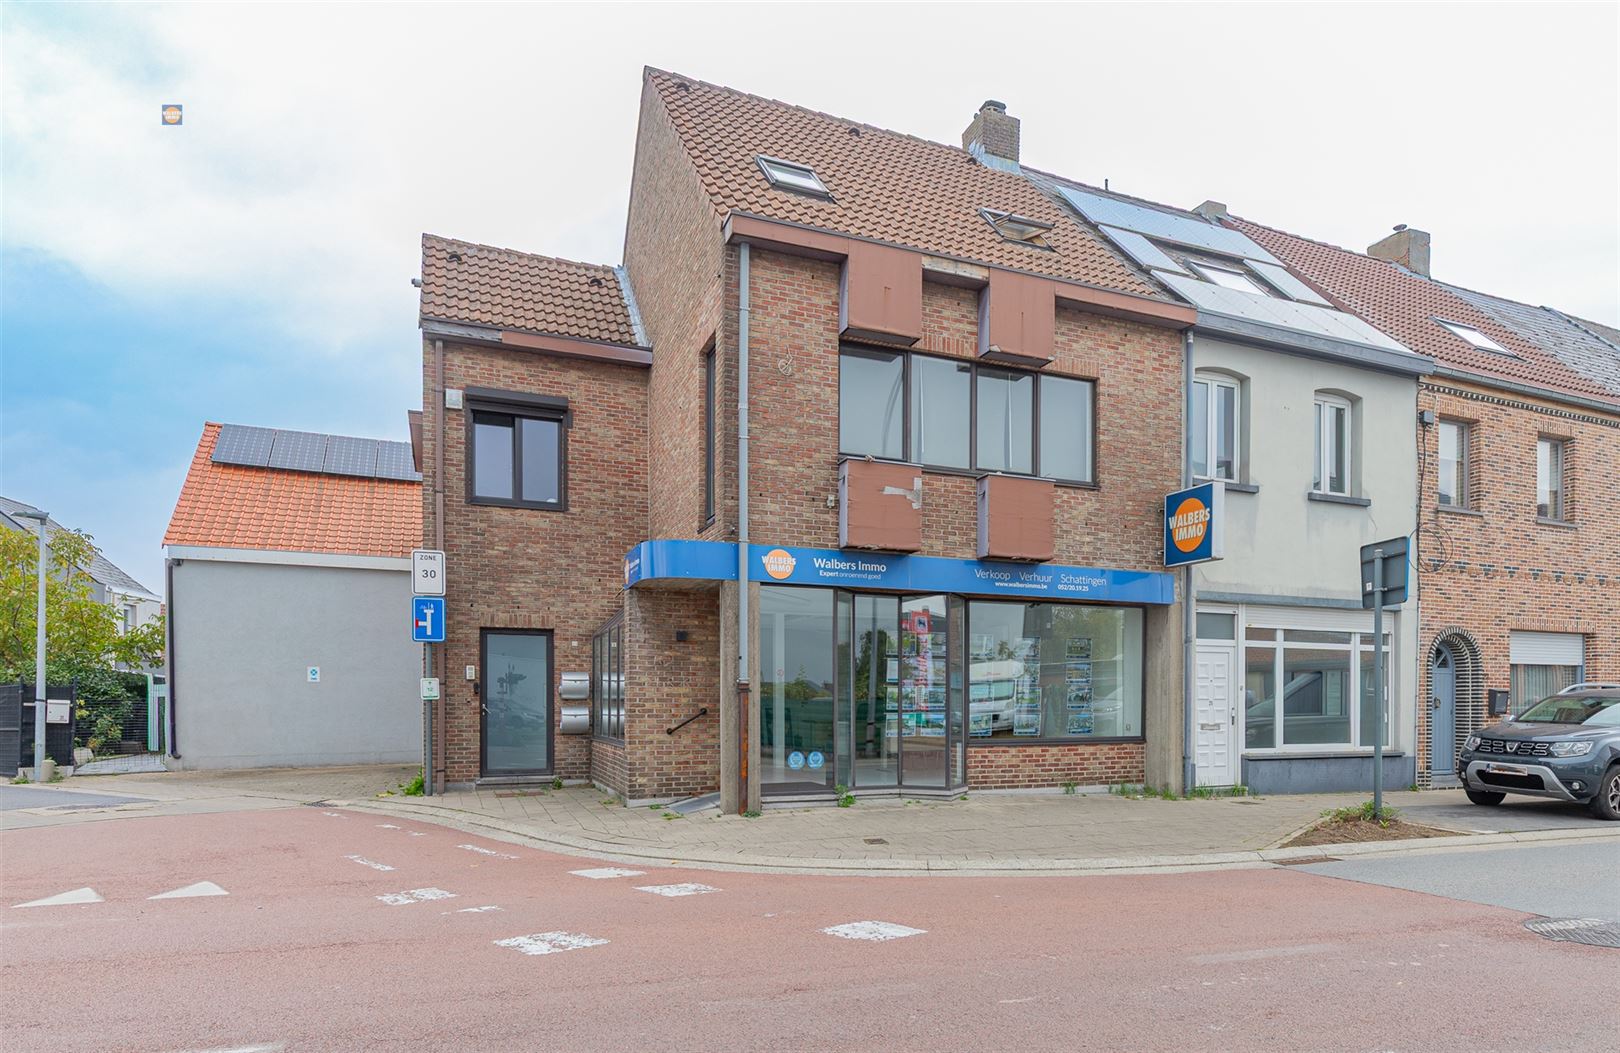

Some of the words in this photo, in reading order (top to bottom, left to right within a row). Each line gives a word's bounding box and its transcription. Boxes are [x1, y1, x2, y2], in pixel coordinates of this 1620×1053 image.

[1168, 507, 1210, 530] WALBERS
[1175, 523, 1204, 541] IMMO
[761, 555, 796, 565] WALBERS
[813, 557, 856, 570] Walbers
[858, 560, 886, 572] Immo
[421, 569, 437, 579] 30
[768, 564, 791, 573] IMMO
[974, 568, 1011, 581] Verkoop
[1019, 571, 1053, 583] Verhuur
[1060, 573, 1107, 587] Schattingen
[995, 581, 1047, 589] www.walbersimmo.be
